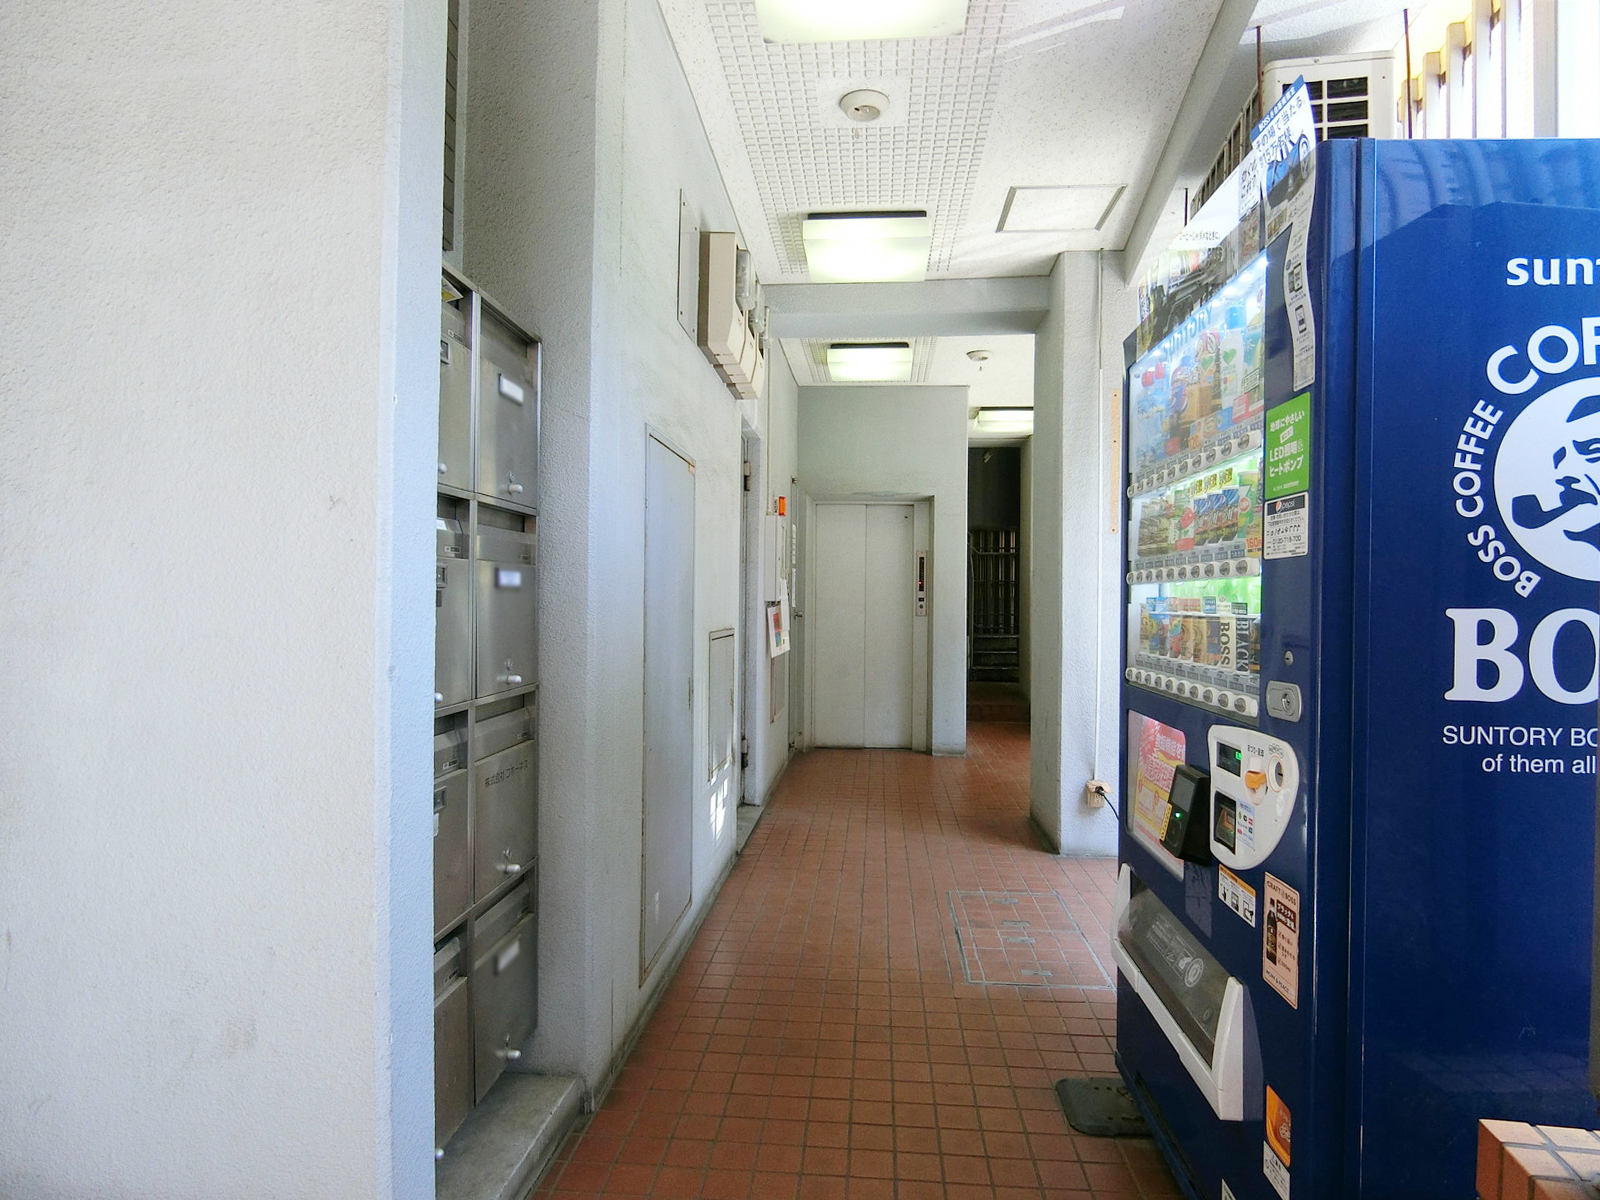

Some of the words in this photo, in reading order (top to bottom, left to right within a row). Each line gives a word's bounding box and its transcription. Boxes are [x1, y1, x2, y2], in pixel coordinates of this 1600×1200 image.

[1270, 454, 1304, 477] ヒートポンプ
[1453, 400, 1503, 518] COFFEE
[1467, 525, 1541, 598] BOSS
[1221, 621, 1231, 666] BOSS
[1236, 619, 1249, 672] BLACK
[1444, 608, 1598, 705] BO
[1442, 725, 1563, 747] SUNTORY
[1482, 753, 1503, 773] of
[1509, 754, 1564, 773] them
[1572, 755, 1597, 774] all
[1267, 880, 1281, 895] CRAFT
[1285, 893, 1297, 906] BOSS
